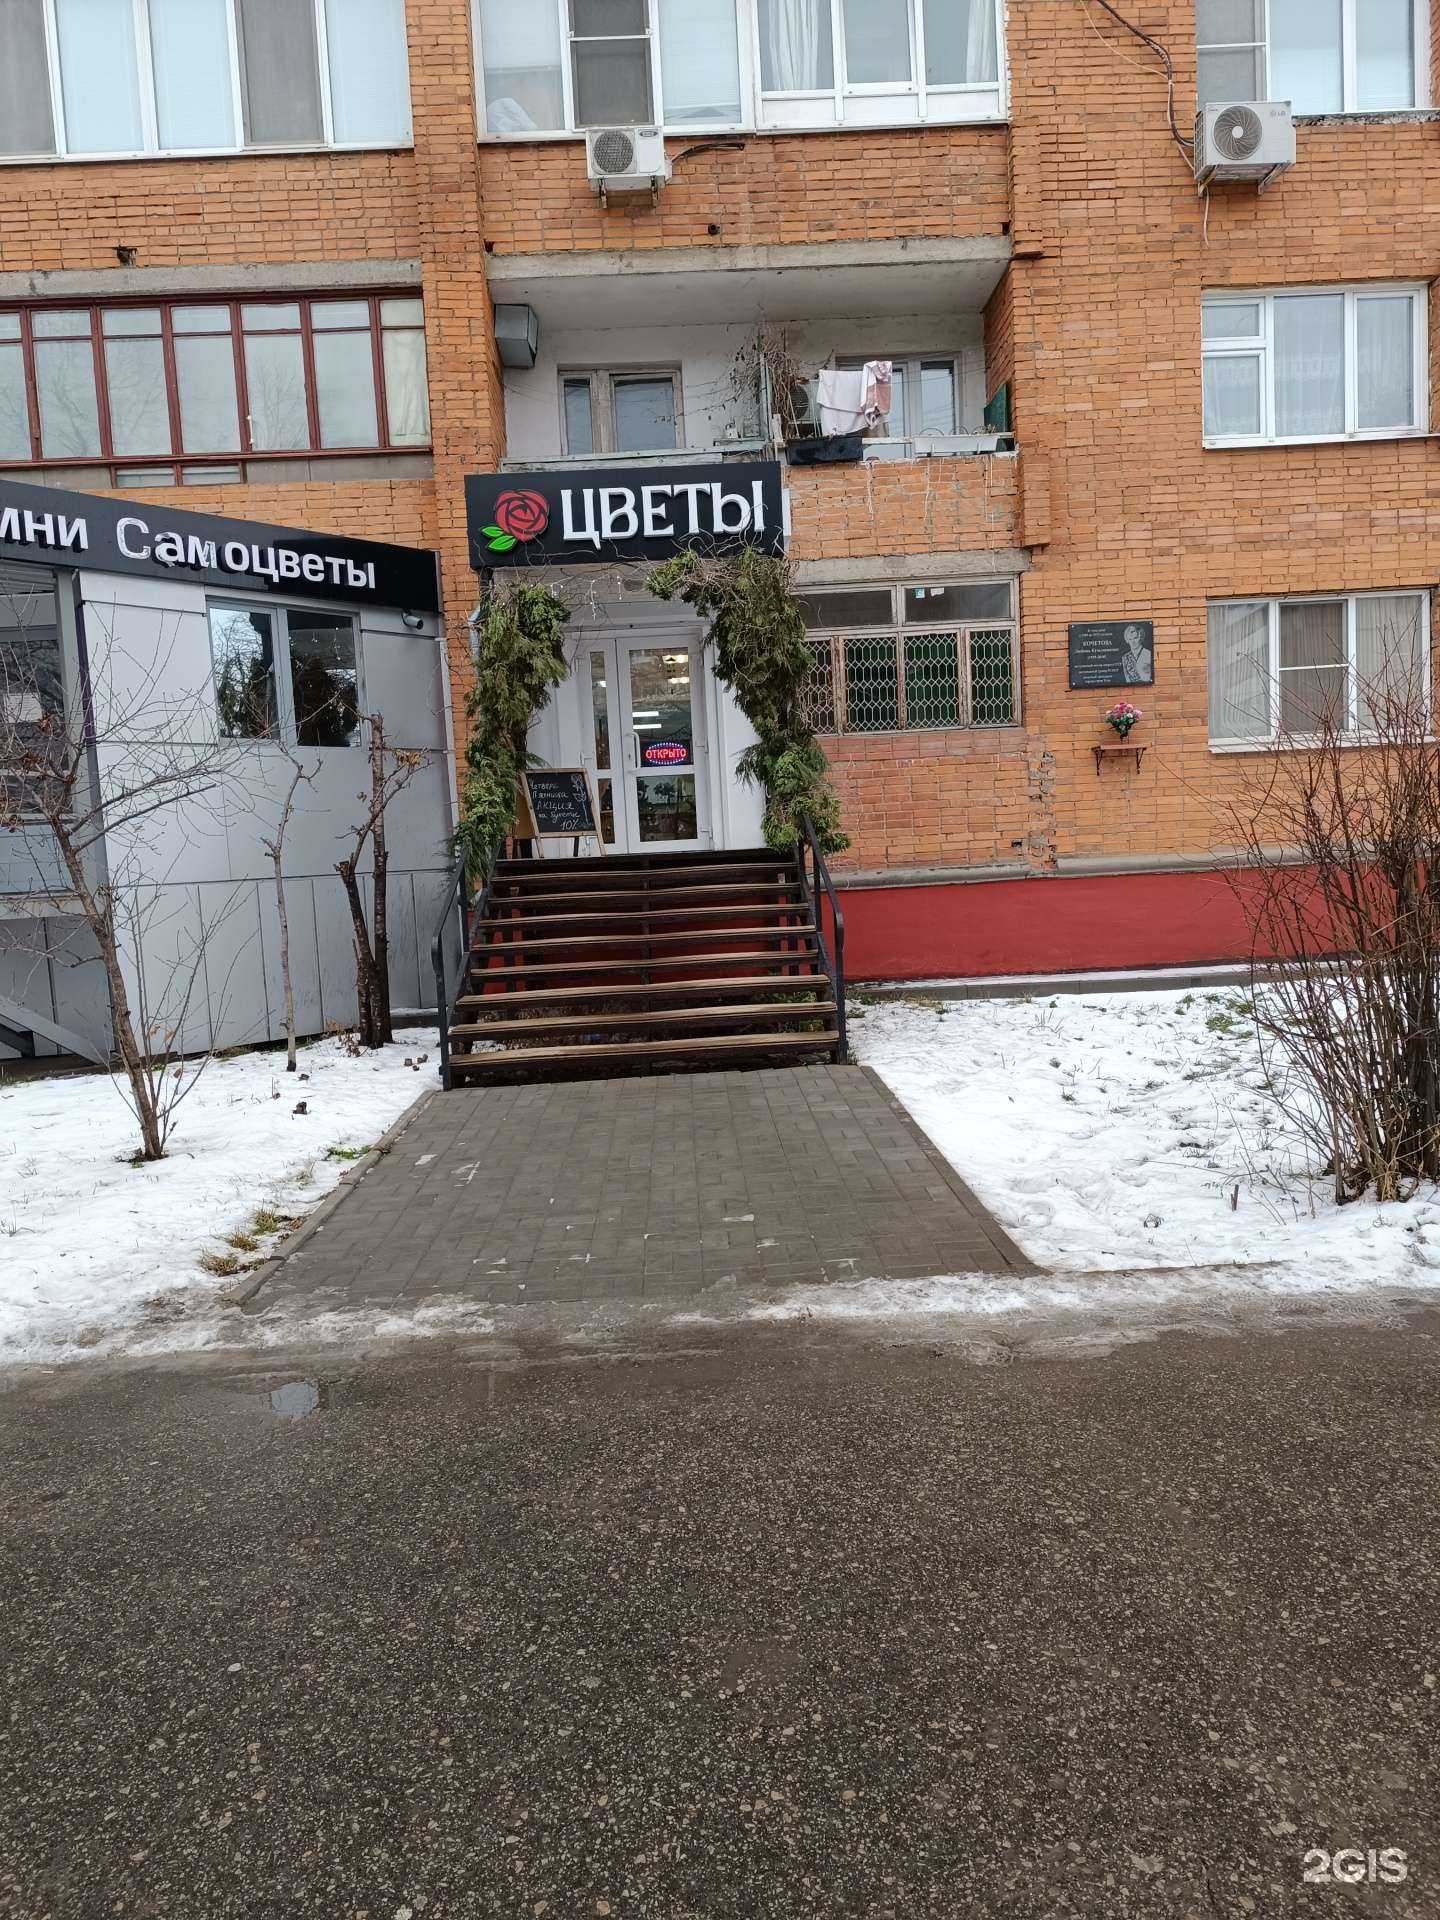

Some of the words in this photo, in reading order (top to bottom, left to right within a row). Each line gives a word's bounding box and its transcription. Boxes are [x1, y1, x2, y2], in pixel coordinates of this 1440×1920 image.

[560, 480, 765, 550] ЦВЕТЫ
[116, 517, 376, 589] Самоцветы
[645, 748, 687, 759] ОТКРЫТО
[560, 818, 579, 831] 10%
